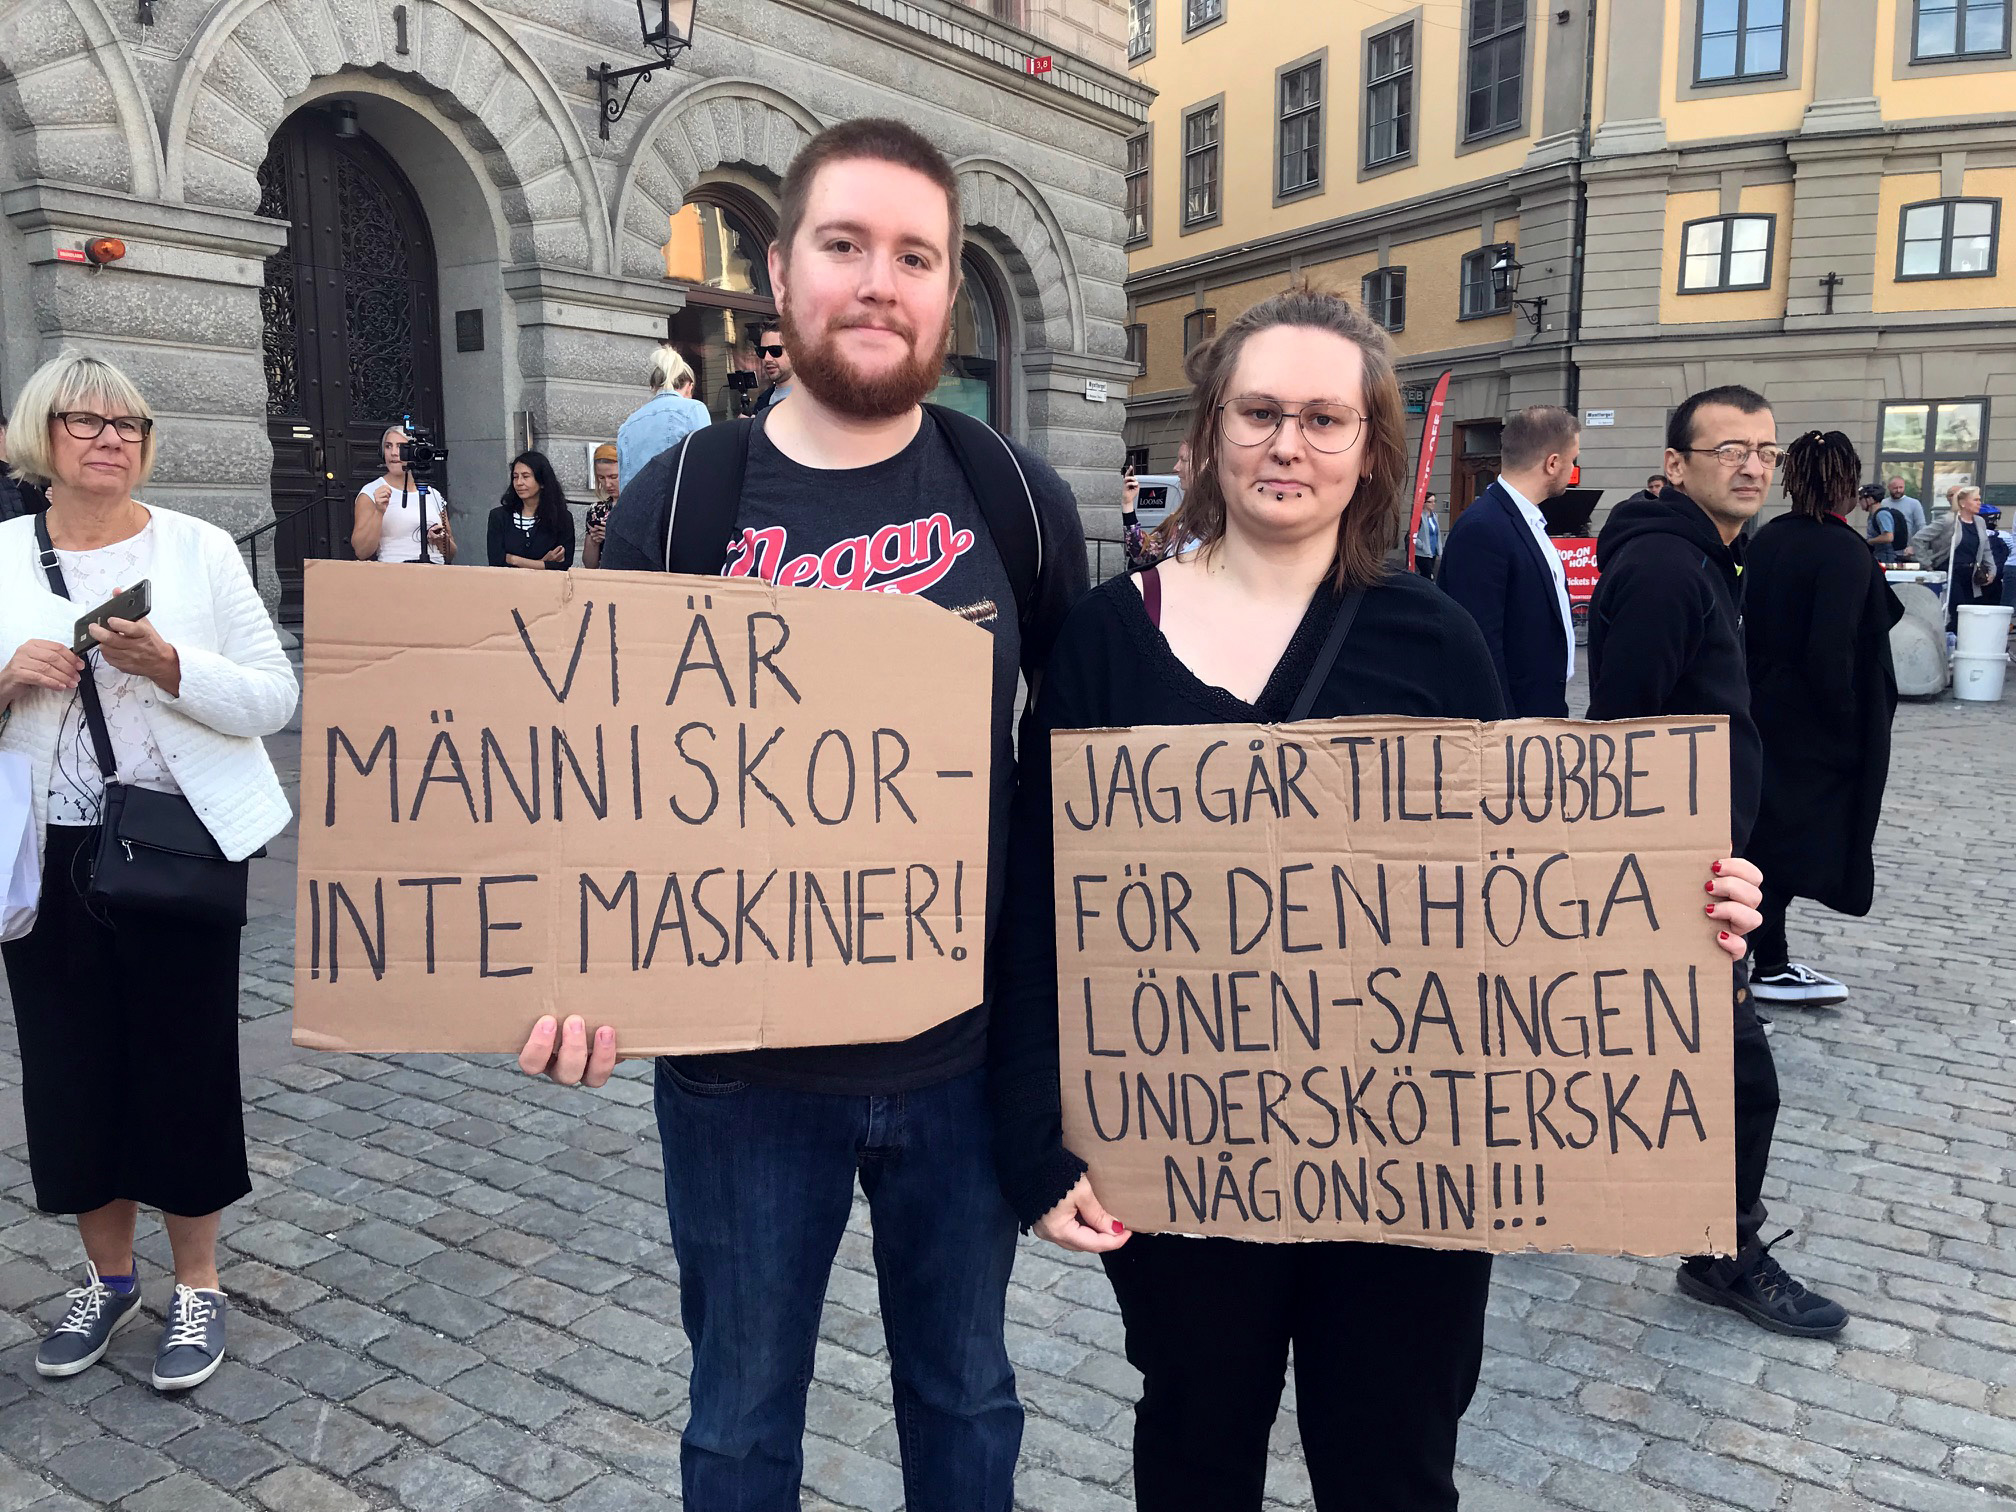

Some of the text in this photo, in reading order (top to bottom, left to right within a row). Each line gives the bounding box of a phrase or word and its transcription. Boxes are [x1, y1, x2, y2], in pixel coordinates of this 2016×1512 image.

[393, 5, 409, 54] 1
[1037, 60, 1048, 70] 3,8
[511, 595, 801, 708] VI ÄR
[325, 709, 974, 828] MÄNNISKOR-
[1065, 725, 1716, 832] JAG GÅR TILL JOBBET
[309, 860, 968, 983] INTE MASKINER!
[1073, 848, 1660, 955] FÖR DEN HÖGA
[1478, 965, 1701, 1059] INGEN
[1084, 1066, 1707, 1154] UNDERSKÖTERSKA
[1164, 1151, 1548, 1231] NÅGONSIN!!!
